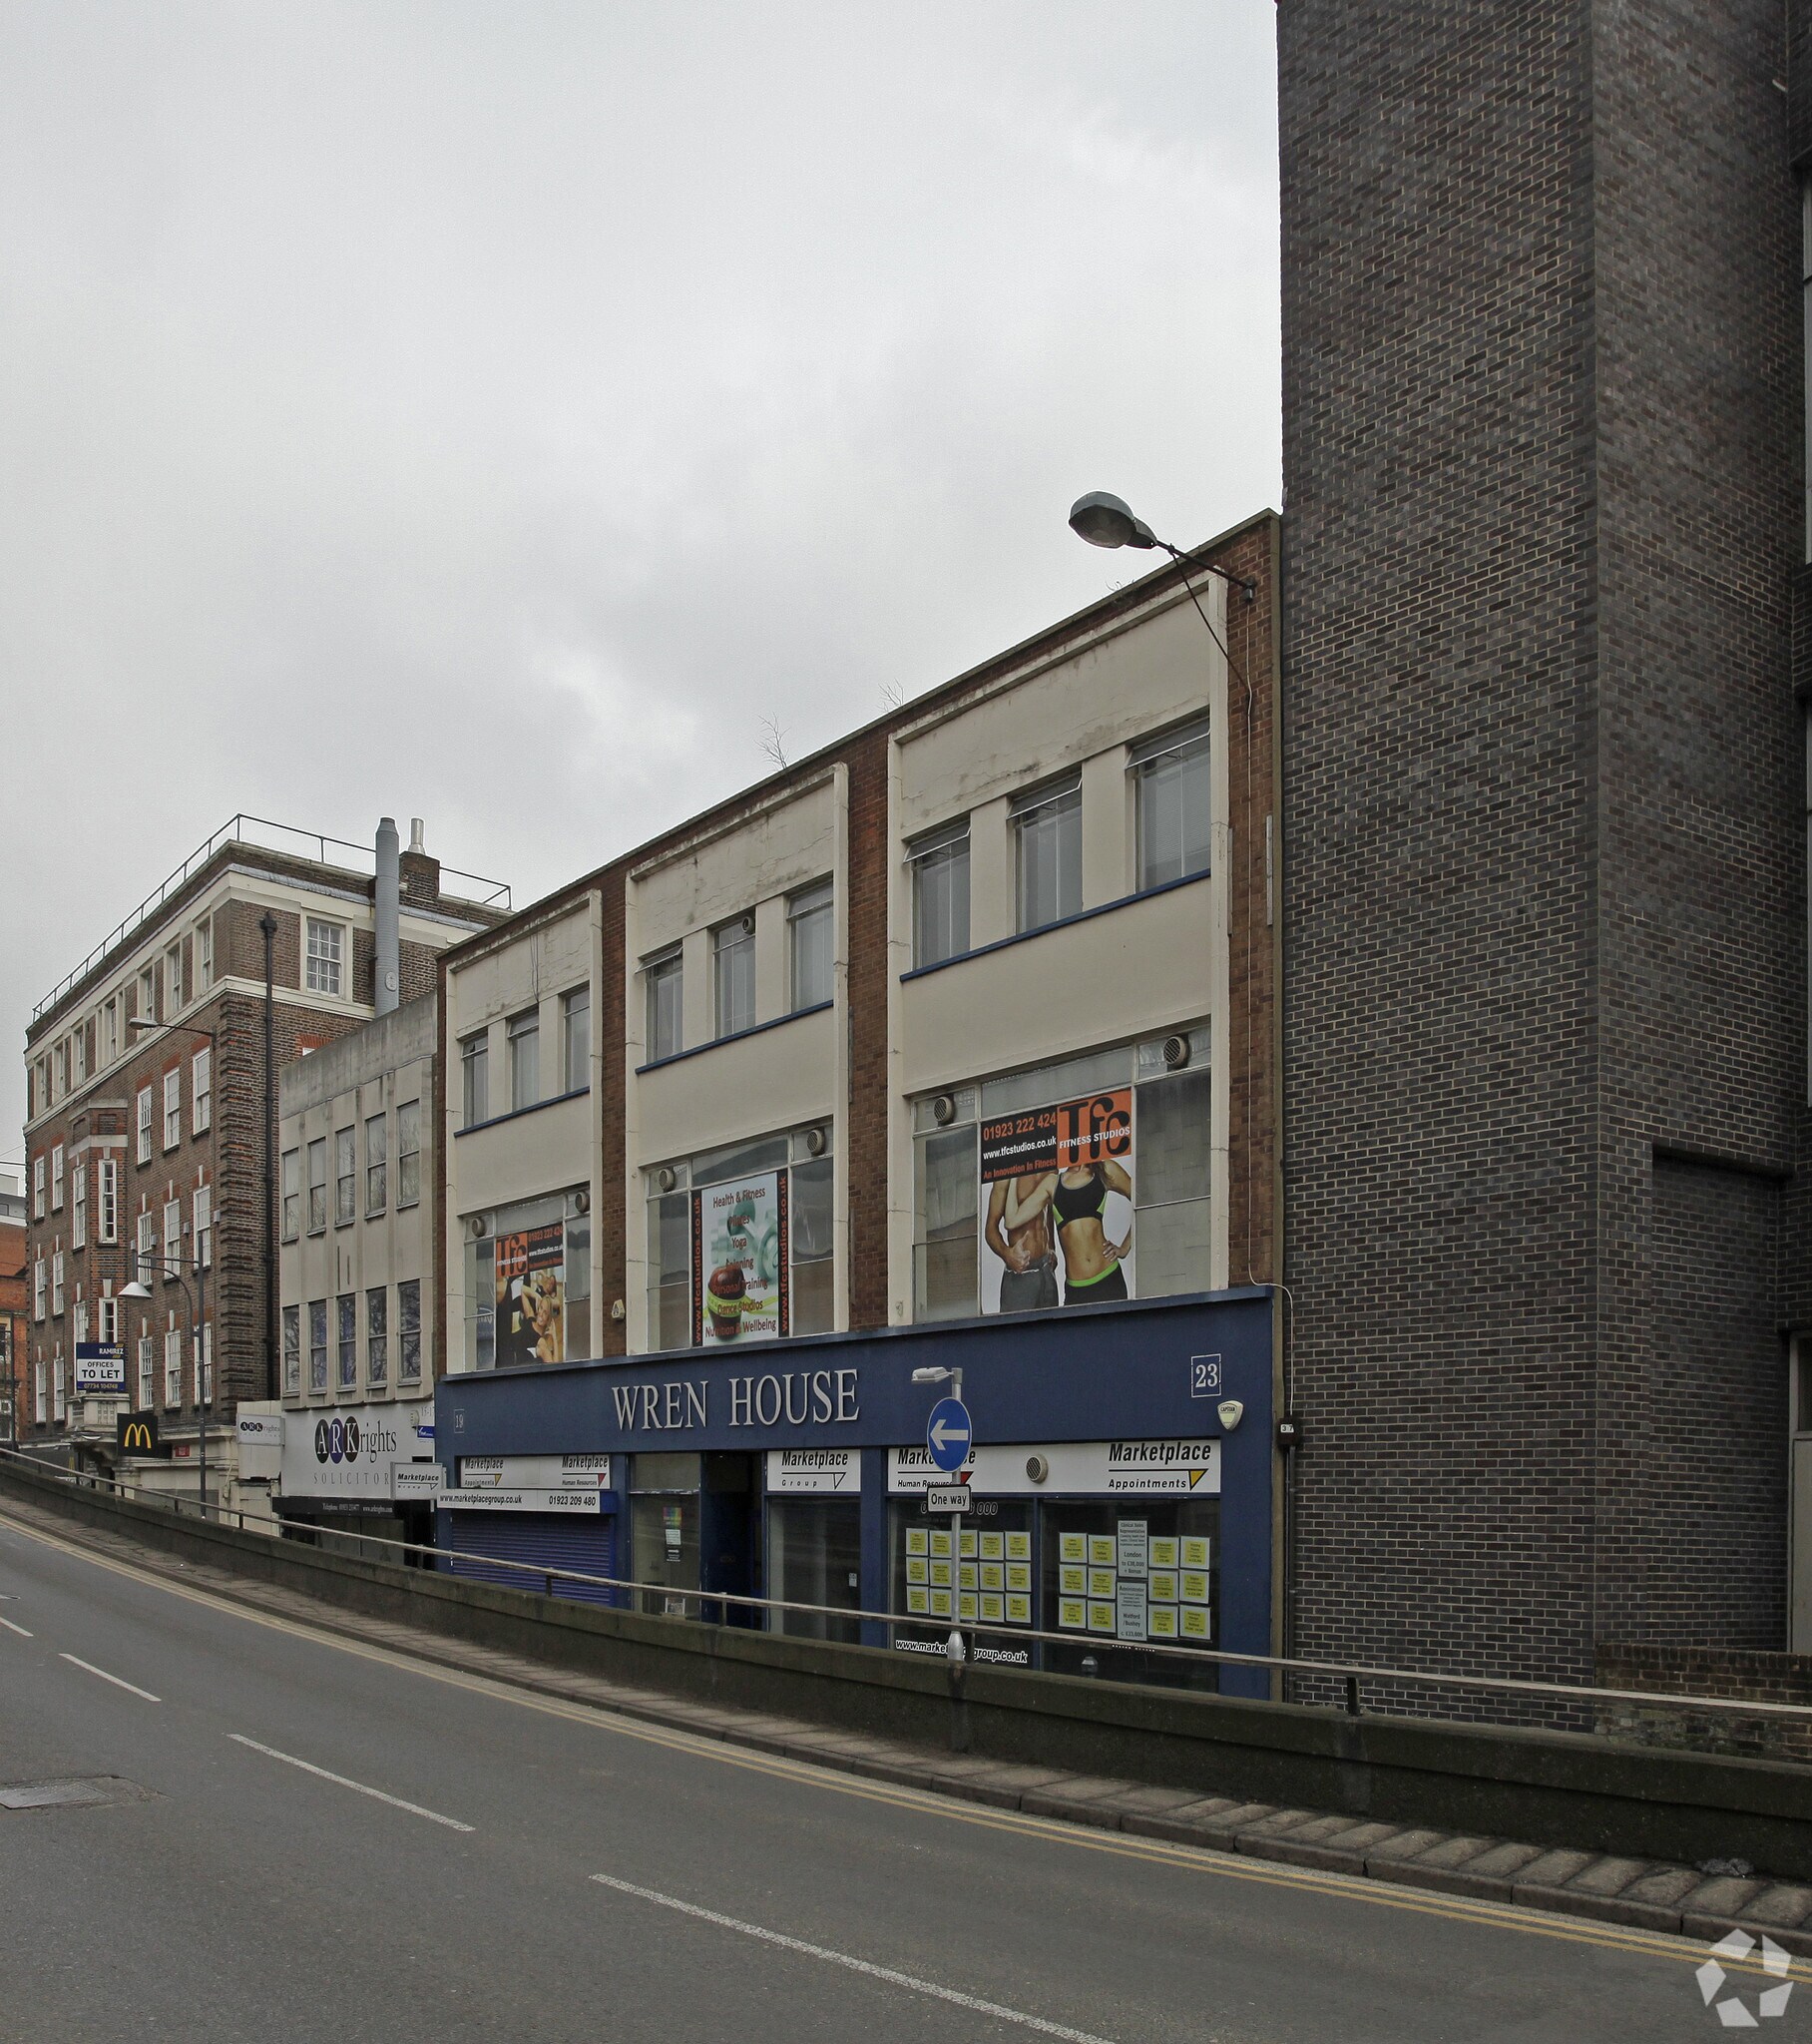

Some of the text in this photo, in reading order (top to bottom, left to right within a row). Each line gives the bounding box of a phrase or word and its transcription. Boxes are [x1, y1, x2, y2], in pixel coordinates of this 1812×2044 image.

[983, 1112, 1057, 1141] 01923 222 424
[1060, 1097, 1131, 1164] Tfc
[1060, 1126, 1131, 1149] FITNESS STUDIOS
[983, 1136, 1057, 1160] www.tfcstudios.co.uk
[993, 1163, 1025, 1178] Innovation
[1035, 1158, 1057, 1171] Fitness
[712, 1188, 766, 1209] Health & Fitness
[731, 1238, 747, 1250] Yoga
[712, 1277, 768, 1294] Personal Training
[718, 1298, 763, 1315] Dance Studios
[743, 1317, 776, 1332] Wellbeing
[82, 1369, 120, 1378] TO LET
[1195, 1363, 1218, 1388] 23
[612, 1368, 860, 1430] WREN HOUSE
[455, 1414, 464, 1428] 19
[781, 1451, 848, 1469] Marketplace
[1109, 1442, 1211, 1465] Marketplace
[465, 1457, 504, 1471] Marketplace
[562, 1455, 608, 1470] Marketplace
[313, 1472, 390, 1485] SOLICITOR
[397, 1473, 439, 1482] Marketplace
[1109, 1478, 1186, 1490] Appointments
[439, 1494, 522, 1506] www.marketplacegroup.co.uk
[549, 1495, 597, 1506] 01923 209 480
[931, 1493, 967, 1506] One way
[896, 1639, 1028, 1664] www.marketgroup.co.uk
